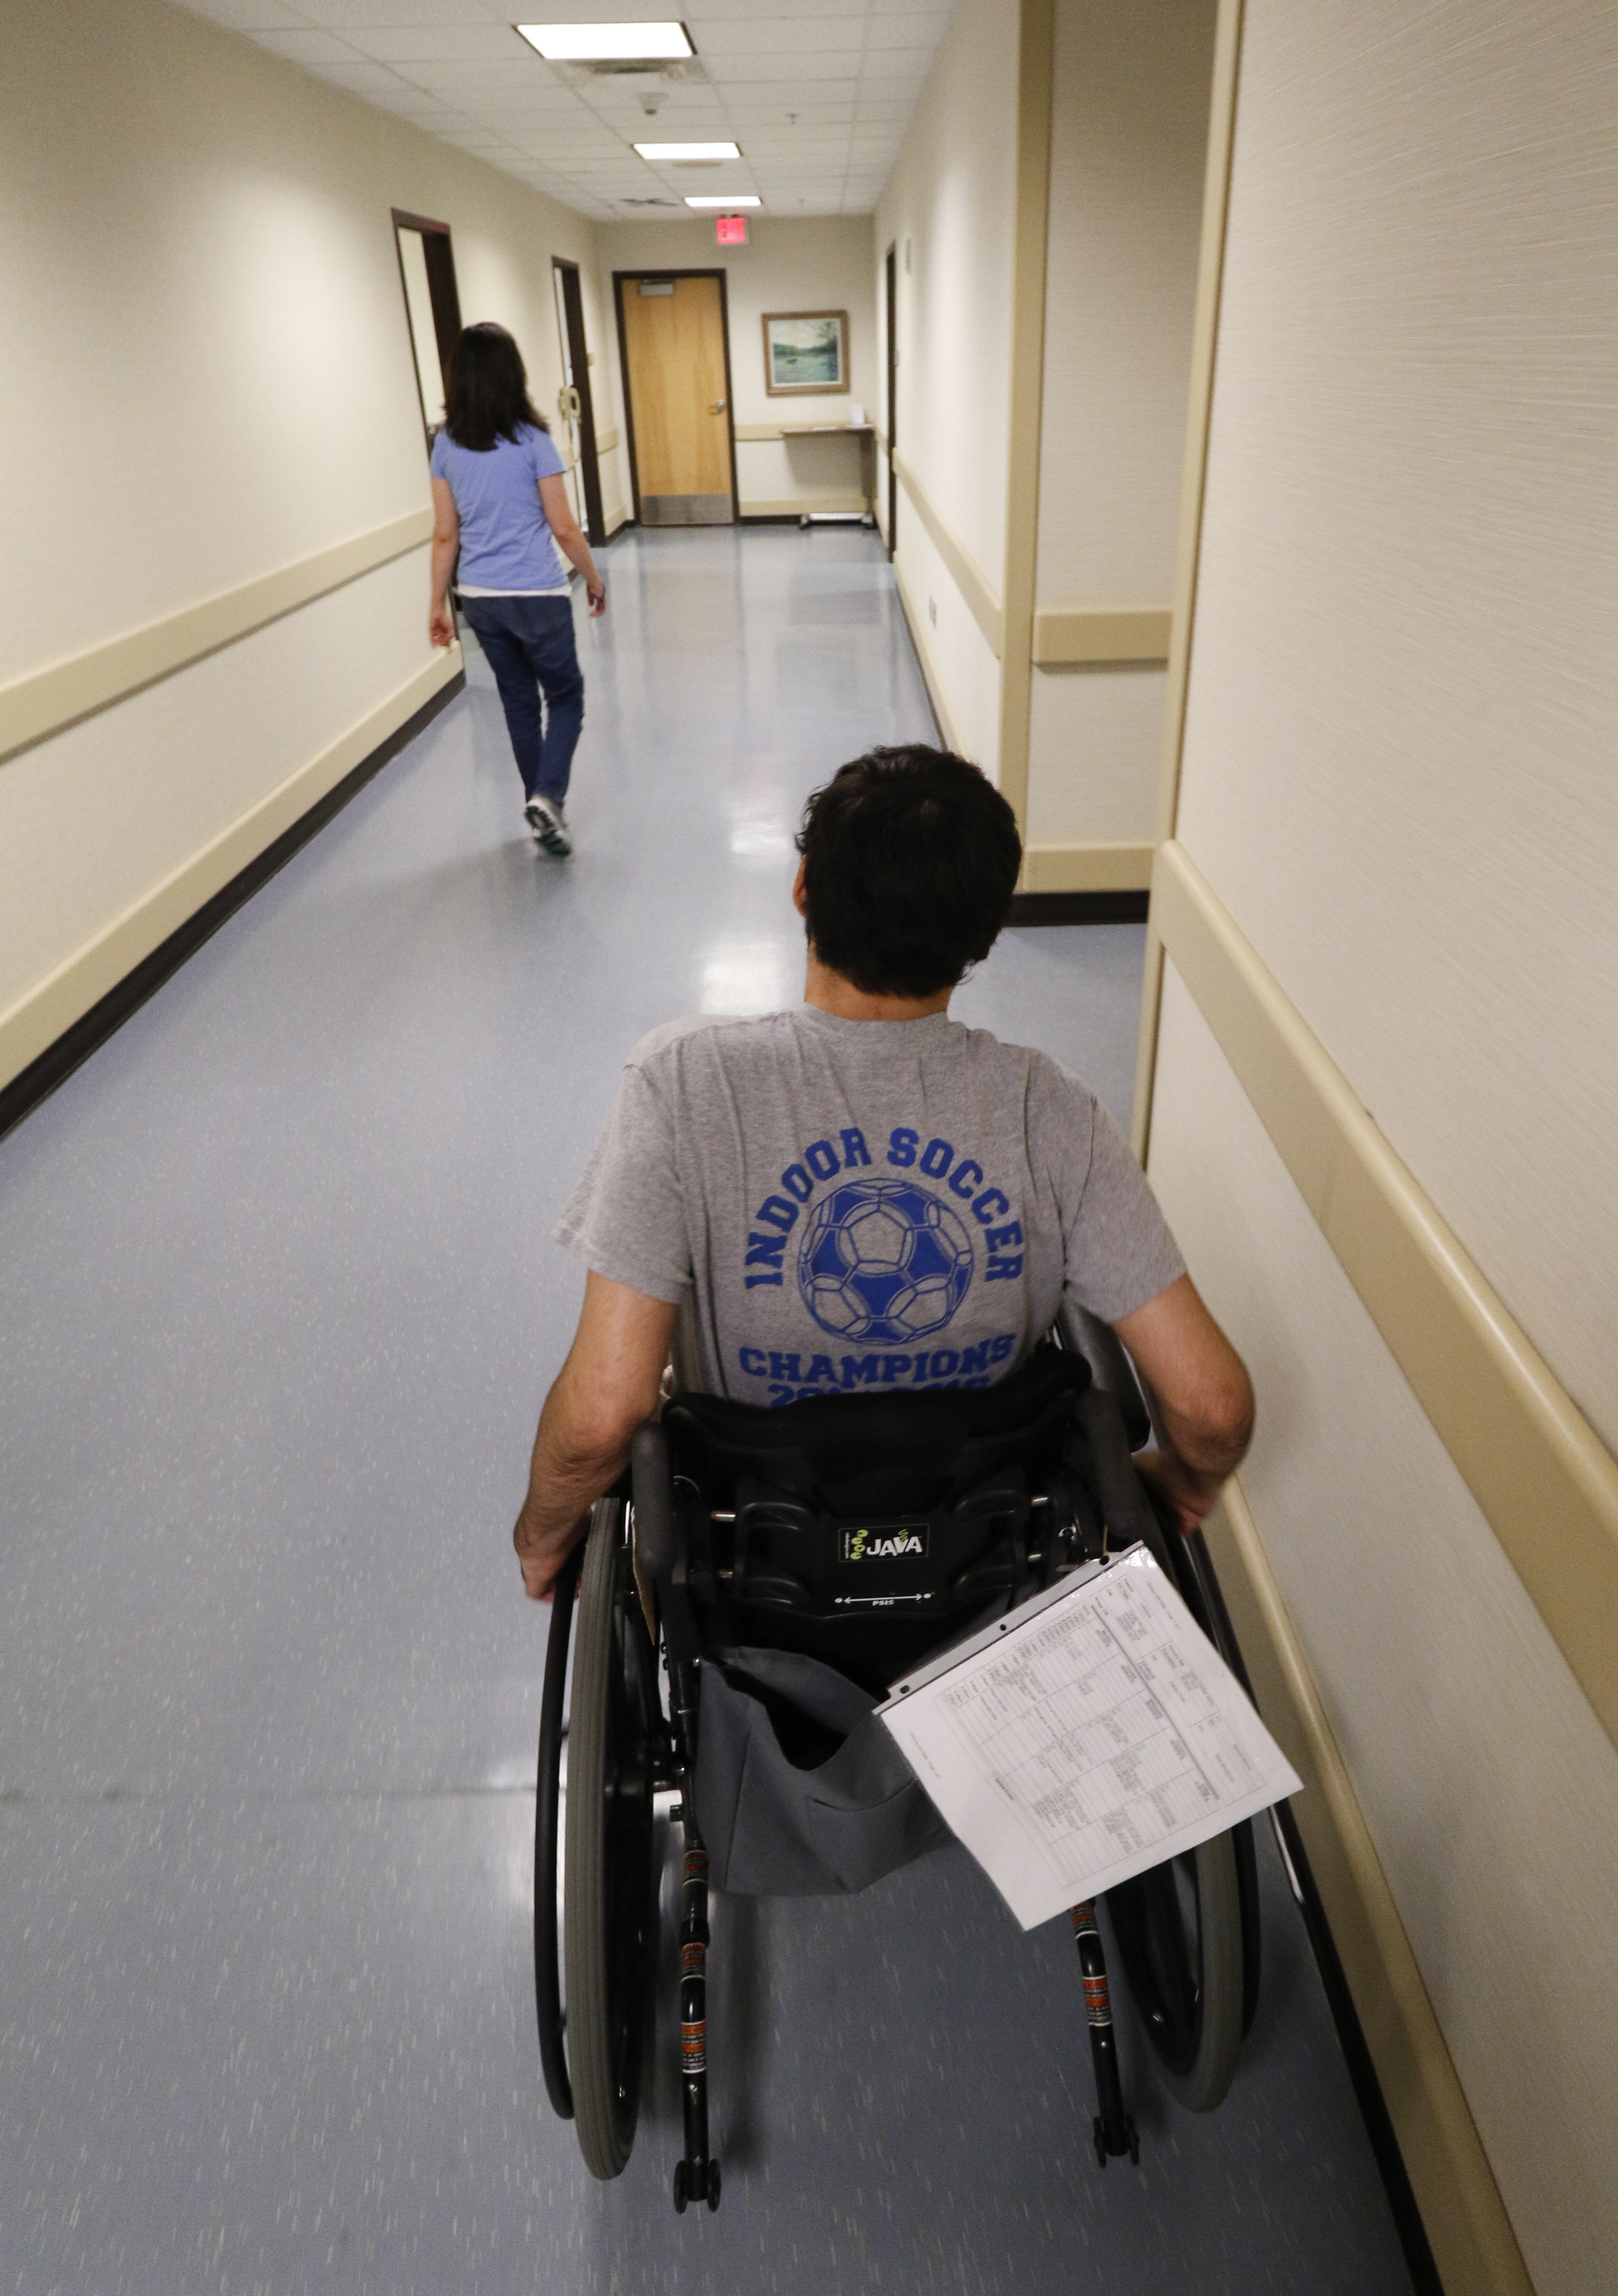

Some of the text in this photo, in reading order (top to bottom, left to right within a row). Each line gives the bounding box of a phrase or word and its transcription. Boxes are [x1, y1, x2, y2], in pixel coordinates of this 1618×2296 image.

[744, 1127, 1025, 1289] INDOOR SOCCER
[738, 1334, 1017, 1389] CHAMPIONS
[866, 1536, 923, 1556] JAVA
